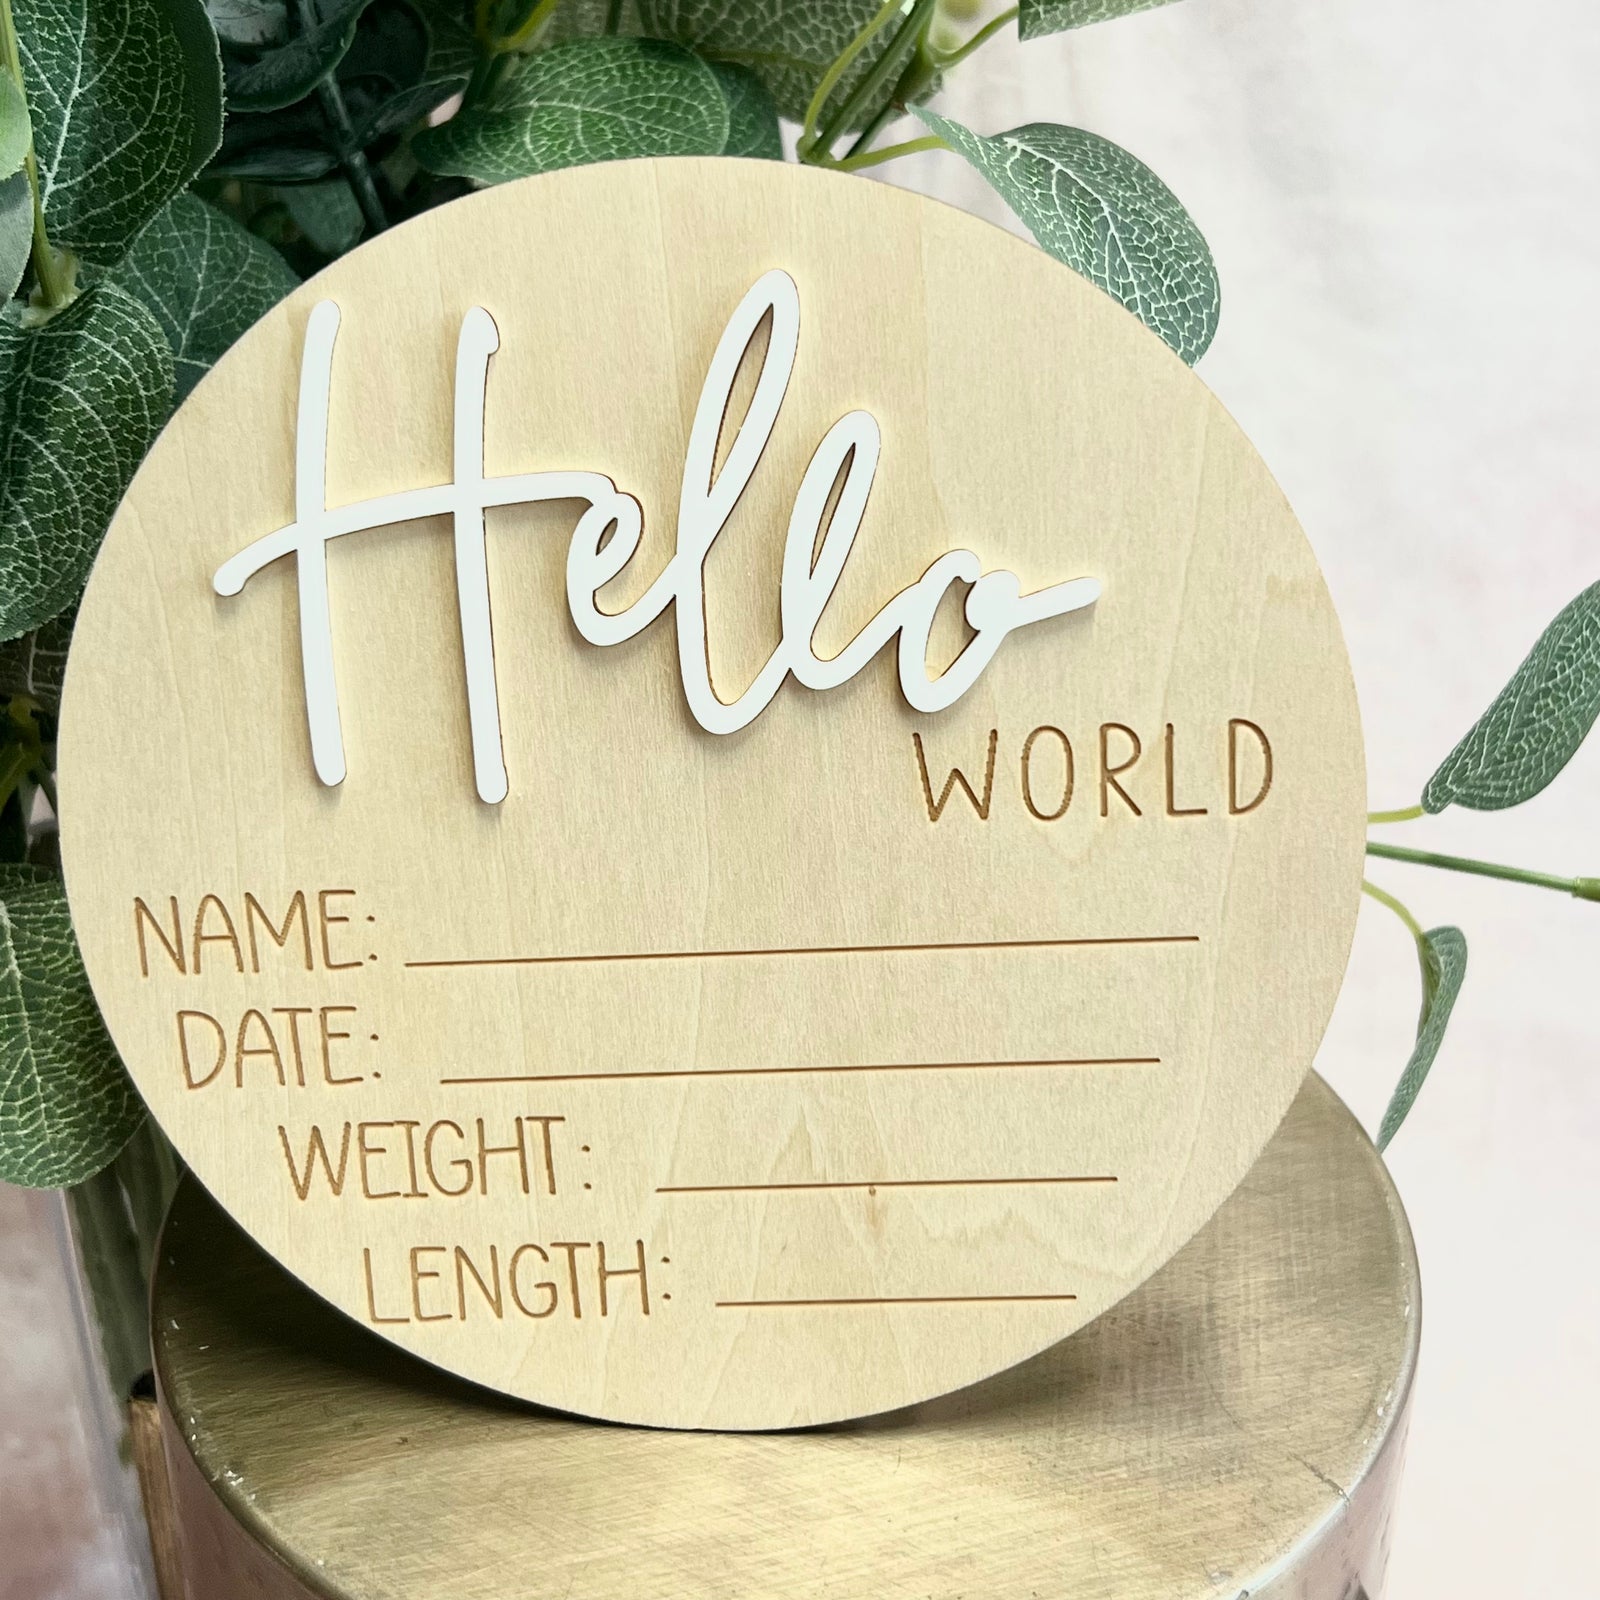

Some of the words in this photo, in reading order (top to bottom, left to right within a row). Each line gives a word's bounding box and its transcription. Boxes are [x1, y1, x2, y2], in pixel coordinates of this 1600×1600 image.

[213, 269, 1103, 805] Hello
[913, 718, 1273, 822] WORLD
[134, 889, 378, 977] NAME:
[177, 1006, 381, 1089] DATE:
[279, 1116, 591, 1199] WEIGHT:
[364, 1240, 671, 1322] LENGTH:
